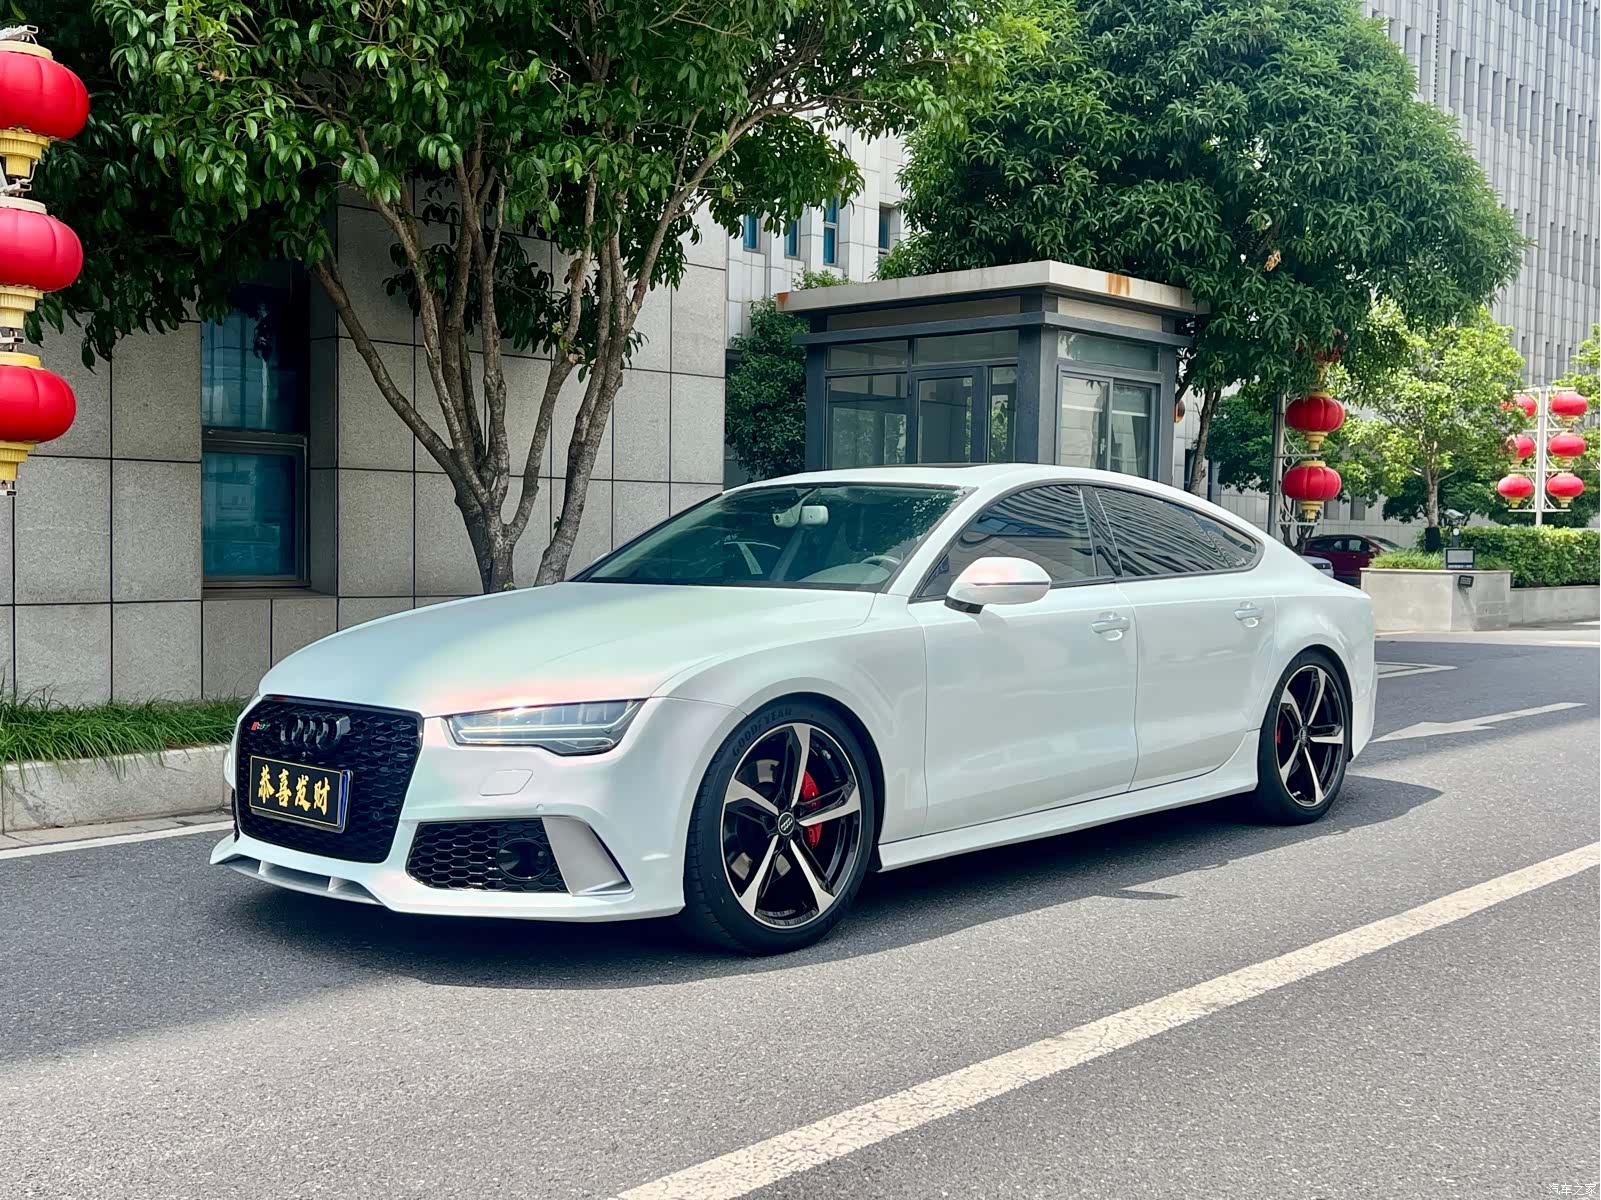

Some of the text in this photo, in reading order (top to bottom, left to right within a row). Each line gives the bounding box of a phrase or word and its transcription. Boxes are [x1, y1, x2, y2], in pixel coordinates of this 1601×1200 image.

[732, 707, 793, 757] GOODYEAR
[258, 764, 331, 816] 恭喜发财
